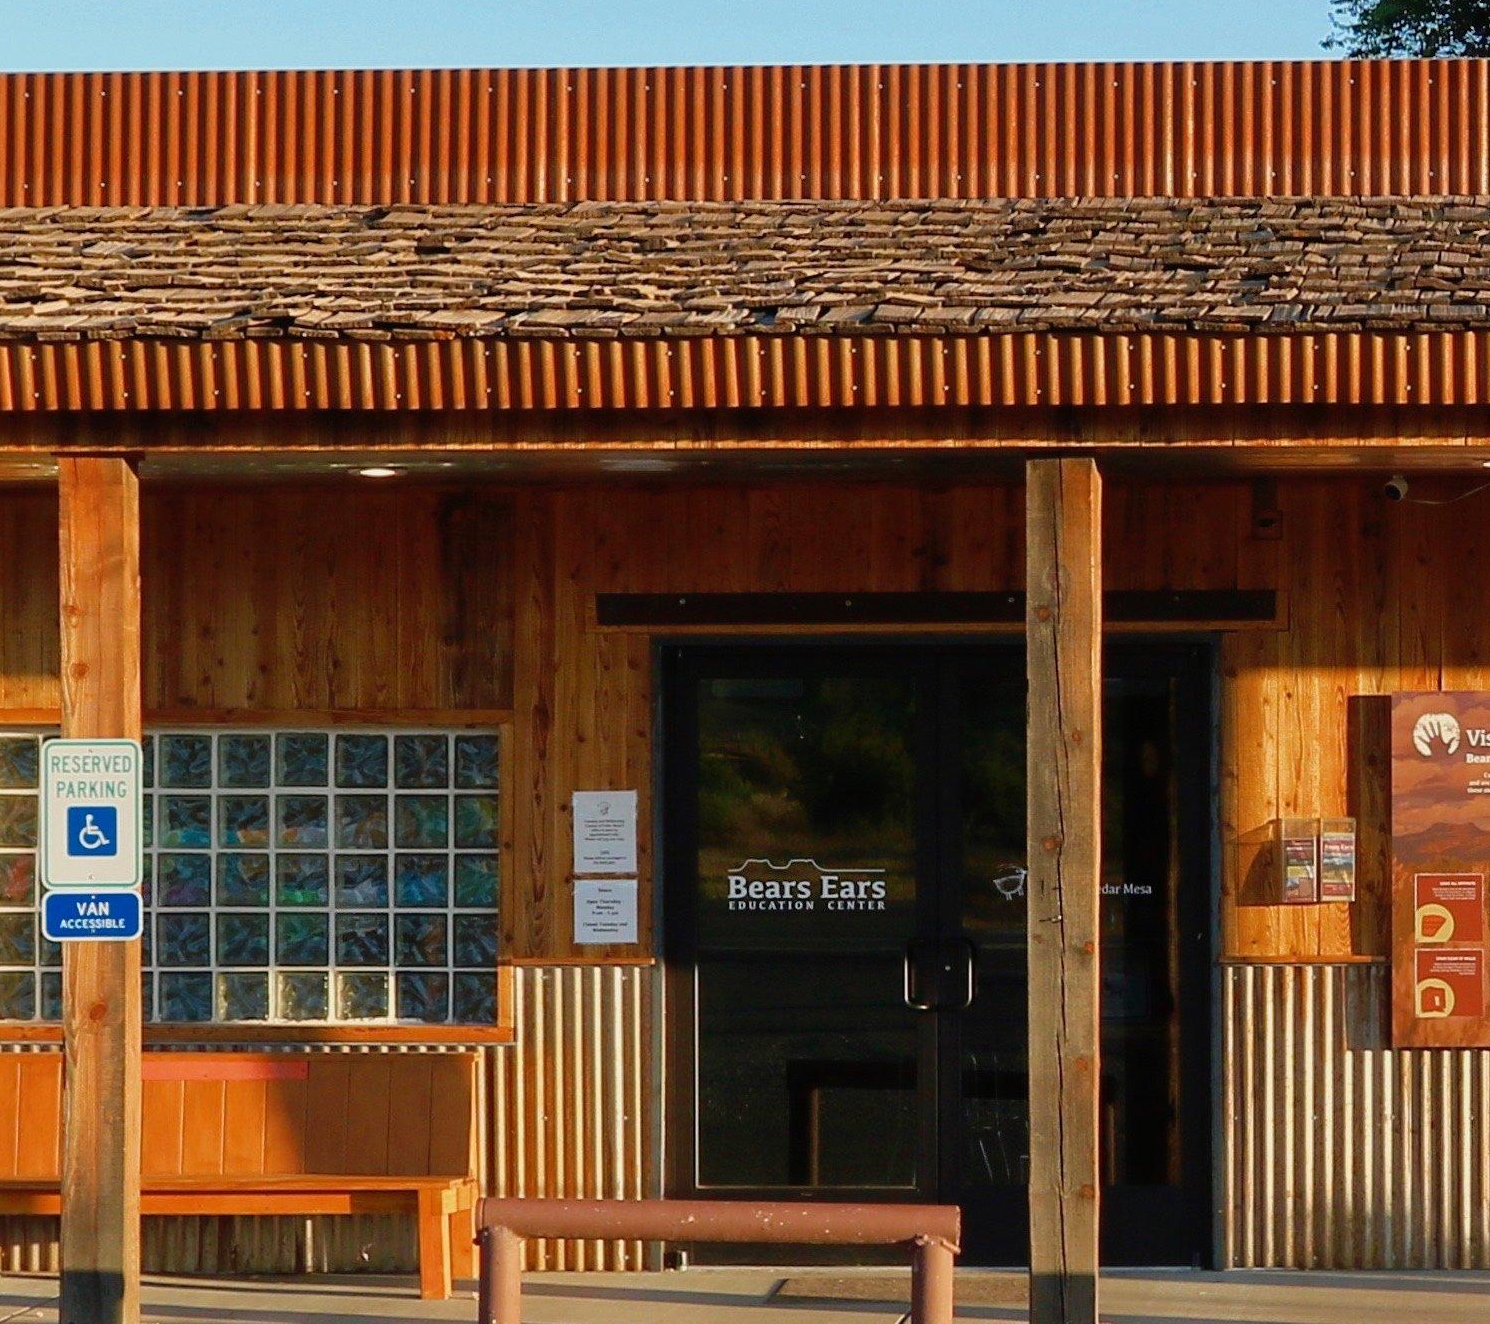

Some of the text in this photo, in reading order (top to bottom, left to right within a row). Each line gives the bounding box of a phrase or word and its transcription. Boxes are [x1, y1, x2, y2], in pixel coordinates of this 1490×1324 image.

[50, 755, 132, 776] RESERVED
[56, 779, 127, 799] PARKING
[728, 876, 886, 899] Bears Ears
[1100, 883, 1152, 894] dar Mesa
[76, 901, 110, 918] VAN
[728, 901, 886, 910] EDUCATION CENTER
[59, 918, 126, 930] ACCESSIBLE
